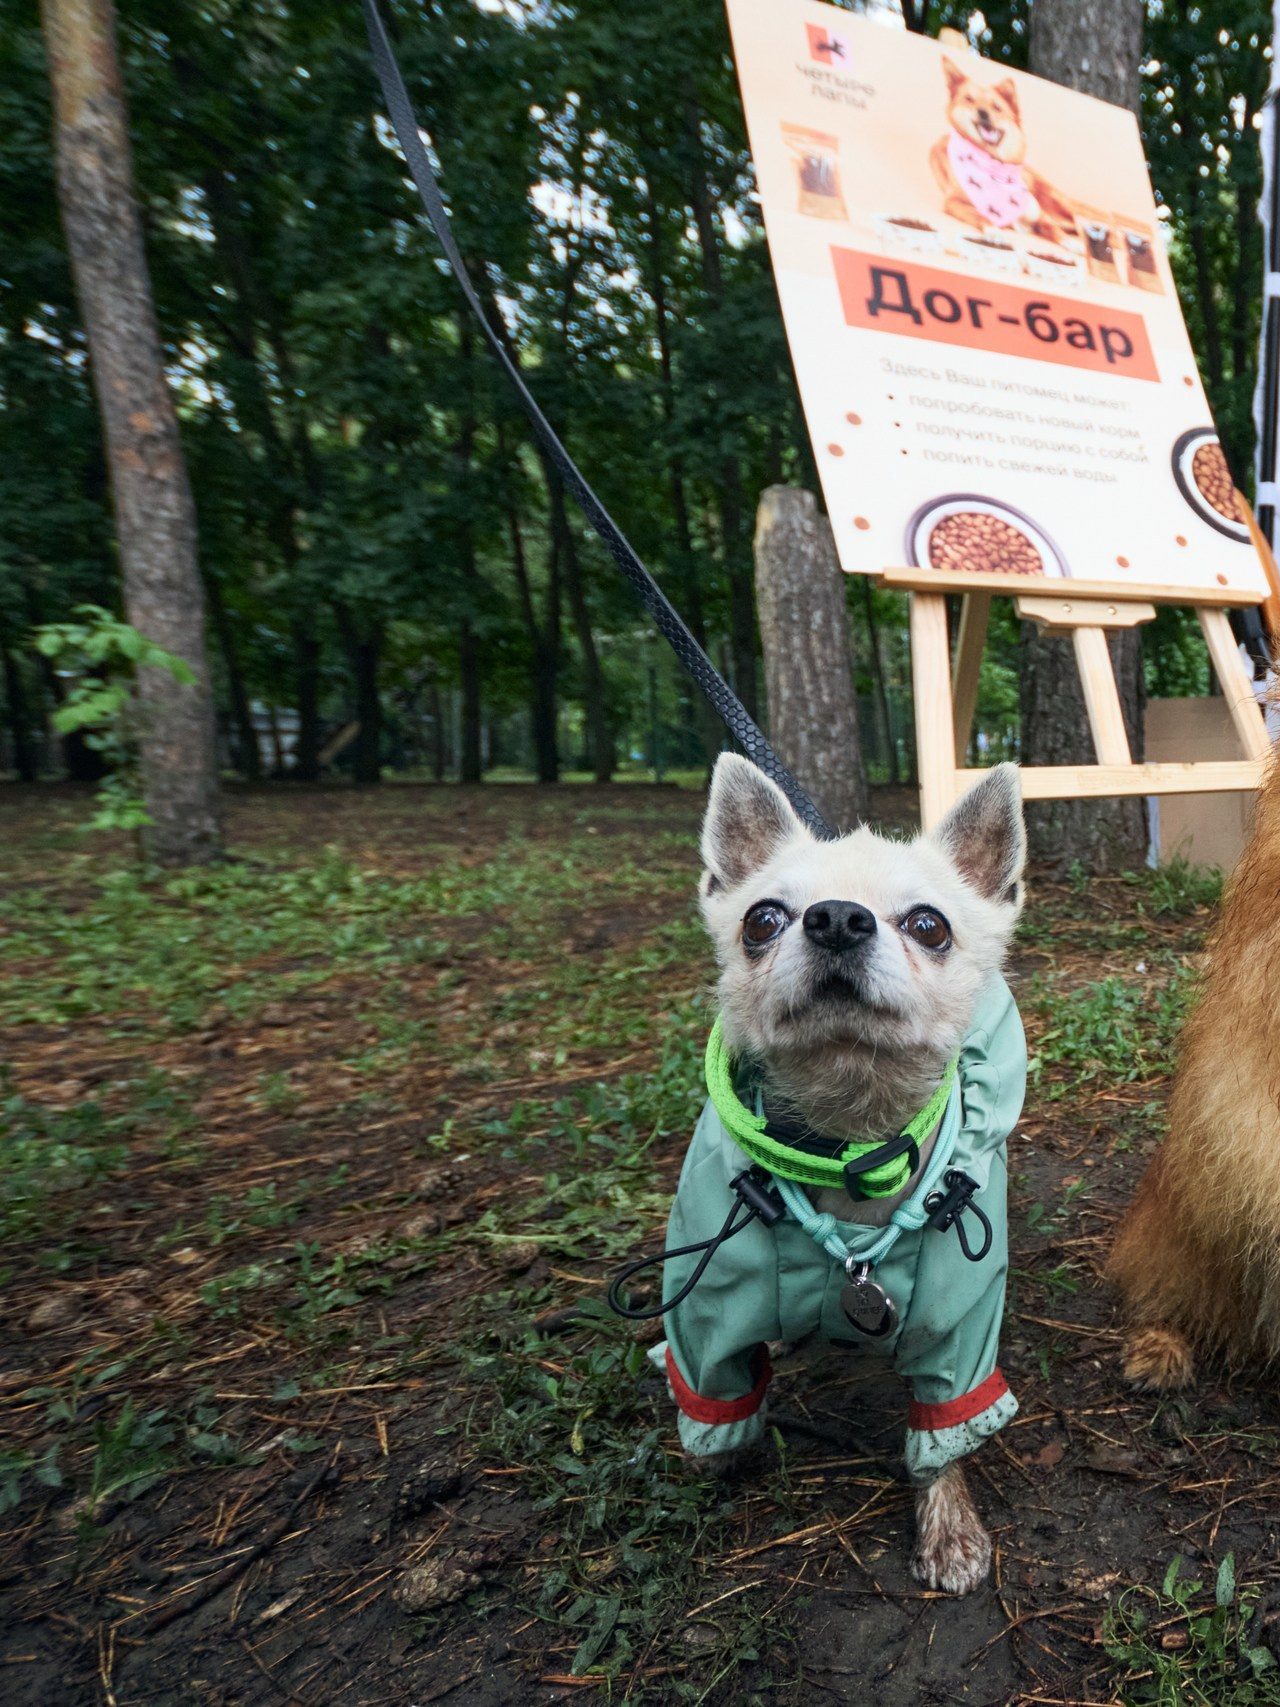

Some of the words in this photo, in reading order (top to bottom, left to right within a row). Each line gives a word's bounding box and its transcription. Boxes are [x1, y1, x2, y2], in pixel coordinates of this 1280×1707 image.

[866, 265, 1134, 364] Дог-бар
[880, 357, 941, 380] Здесь
[946, 368, 986, 388] Ваш
[991, 379, 1069, 403] питомец
[909, 394, 1035, 423] попробовать
[1039, 414, 1094, 432] новый
[1098, 424, 1140, 440] корм
[916, 421, 1006, 444] получить
[1010, 434, 1081, 454] порцию
[1085, 446, 1095, 456] с
[1099, 446, 1149, 463] собой
[923, 448, 994, 468] попить
[998, 457, 1068, 476] свежей
[1073, 468, 1117, 482] воды
